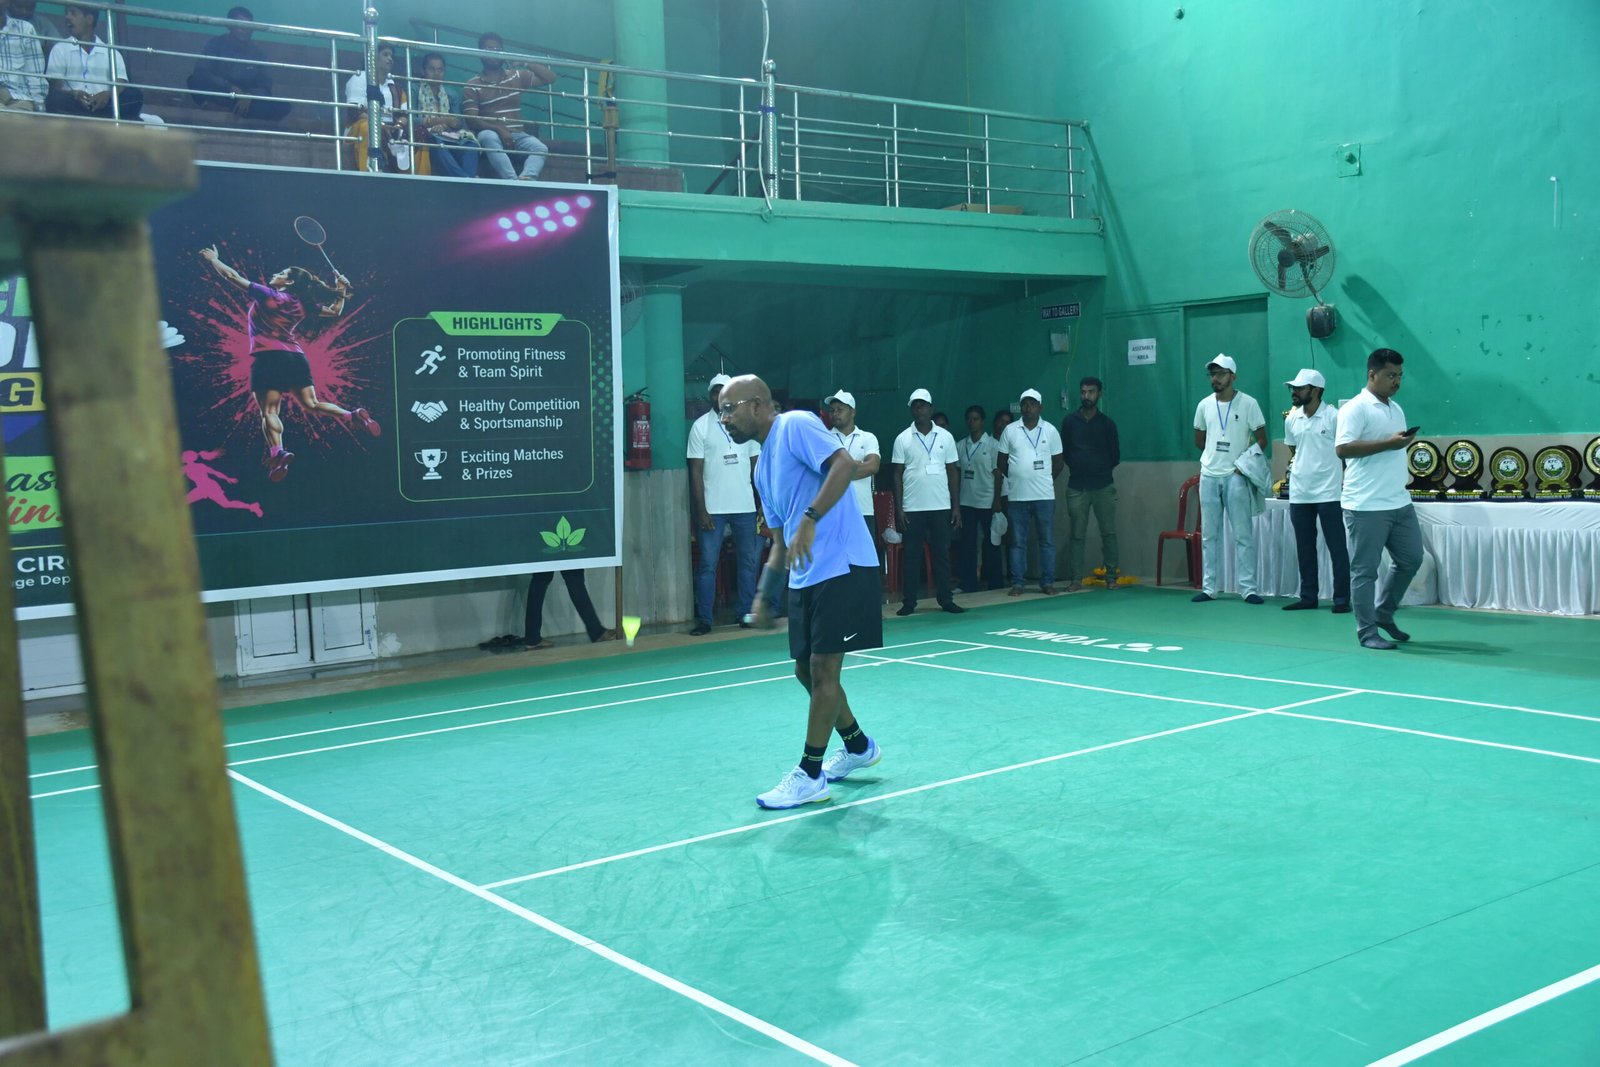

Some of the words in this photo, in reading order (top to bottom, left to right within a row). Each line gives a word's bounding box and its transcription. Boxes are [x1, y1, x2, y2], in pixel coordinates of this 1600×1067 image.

[452, 317, 543, 331] HIGHLIGHTS
[457, 347, 520, 363] Promoting
[523, 347, 566, 360] Fitness
[458, 365, 468, 378] &
[472, 365, 506, 377] Team
[510, 365, 543, 380] Spirit
[459, 399, 505, 414] Healthy
[508, 398, 580, 413] Competition
[460, 417, 470, 430] &
[474, 415, 563, 432] Sportsmanship
[461, 450, 510, 465] Exciting
[513, 448, 564, 461] Matches
[462, 468, 472, 480] &
[476, 467, 513, 480] Prizes
[17, 555, 69, 573] CIR
[12, 579, 35, 590] ge
[984, 628, 1109, 646] YONEX
